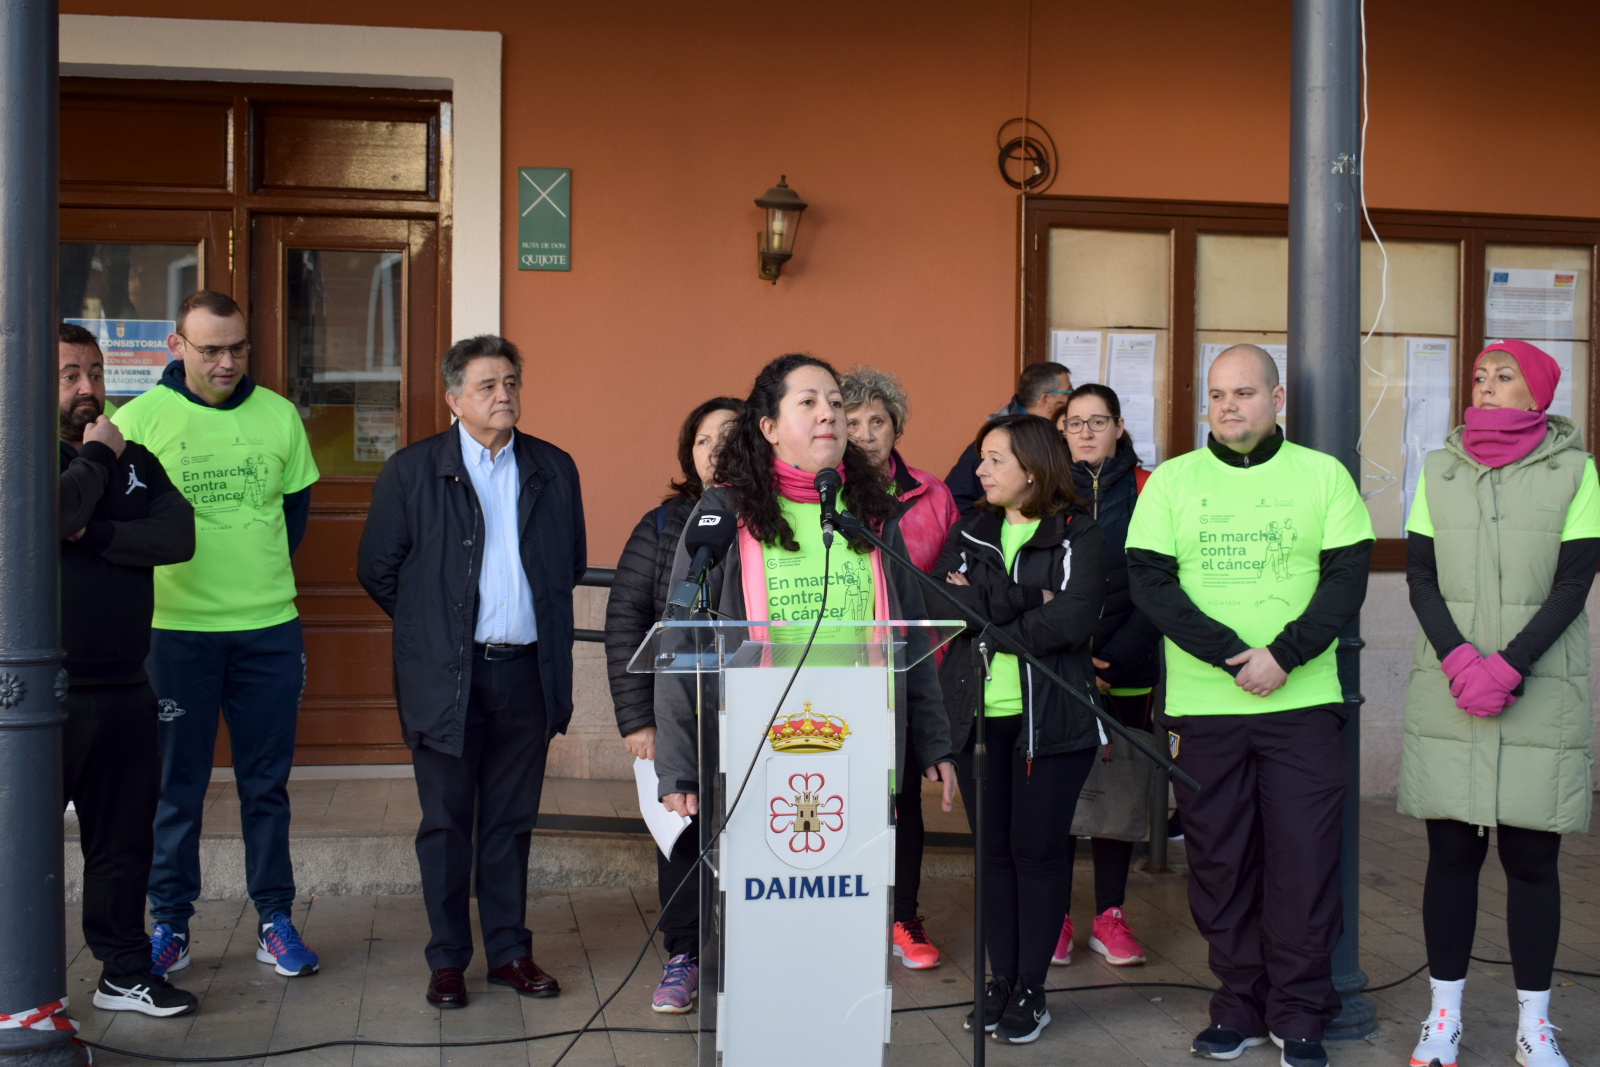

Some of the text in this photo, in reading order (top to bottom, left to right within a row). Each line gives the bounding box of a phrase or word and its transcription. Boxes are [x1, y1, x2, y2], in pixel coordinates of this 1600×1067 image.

[521, 255, 566, 266] QUIJOTE
[99, 340, 167, 348] CONSISTORIAL
[182, 465, 253, 482] En marcha
[183, 480, 227, 494] contra
[201, 492, 245, 504] cáncer
[1199, 529, 1277, 543] En marcha
[1200, 544, 1247, 557] contra
[1201, 557, 1266, 571] el cáncer
[768, 571, 855, 591] En marcha
[769, 590, 823, 608] contra
[771, 605, 846, 621] el cáncer
[744, 874, 869, 900] DAIMIEL
